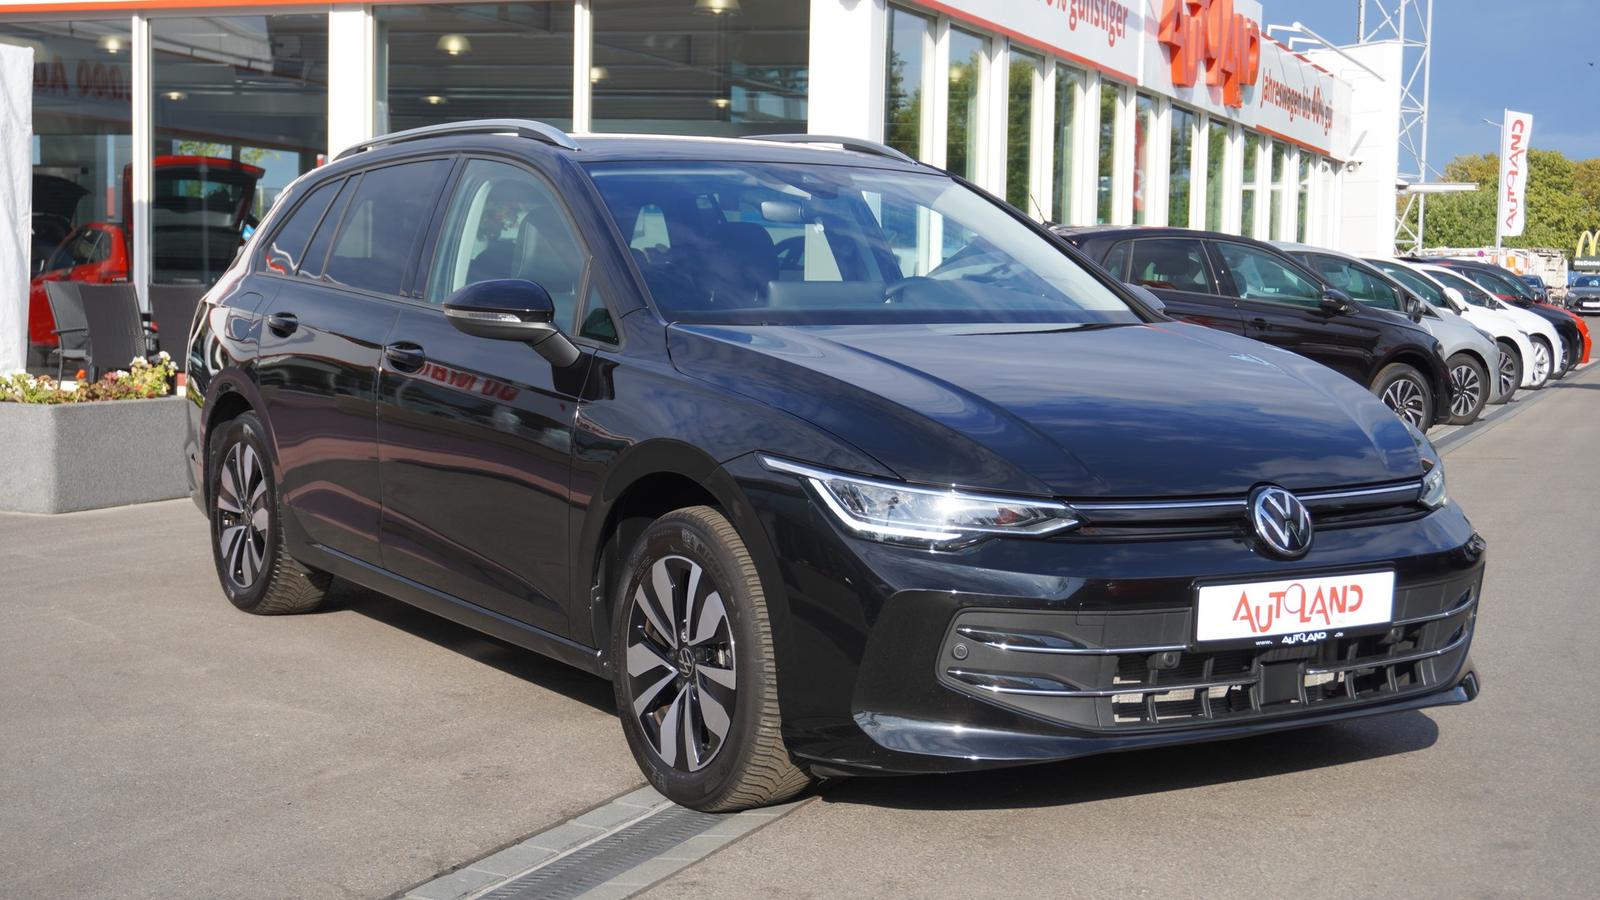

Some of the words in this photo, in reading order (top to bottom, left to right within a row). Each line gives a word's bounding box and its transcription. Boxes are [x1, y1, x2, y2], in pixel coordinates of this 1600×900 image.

[1260, 66, 1302, 123] Jahreswagen
[1506, 119, 1526, 229] AUTOLAND
[1232, 583, 1364, 633] AUTOLAND
[1281, 631, 1327, 645] AUTOLAND
